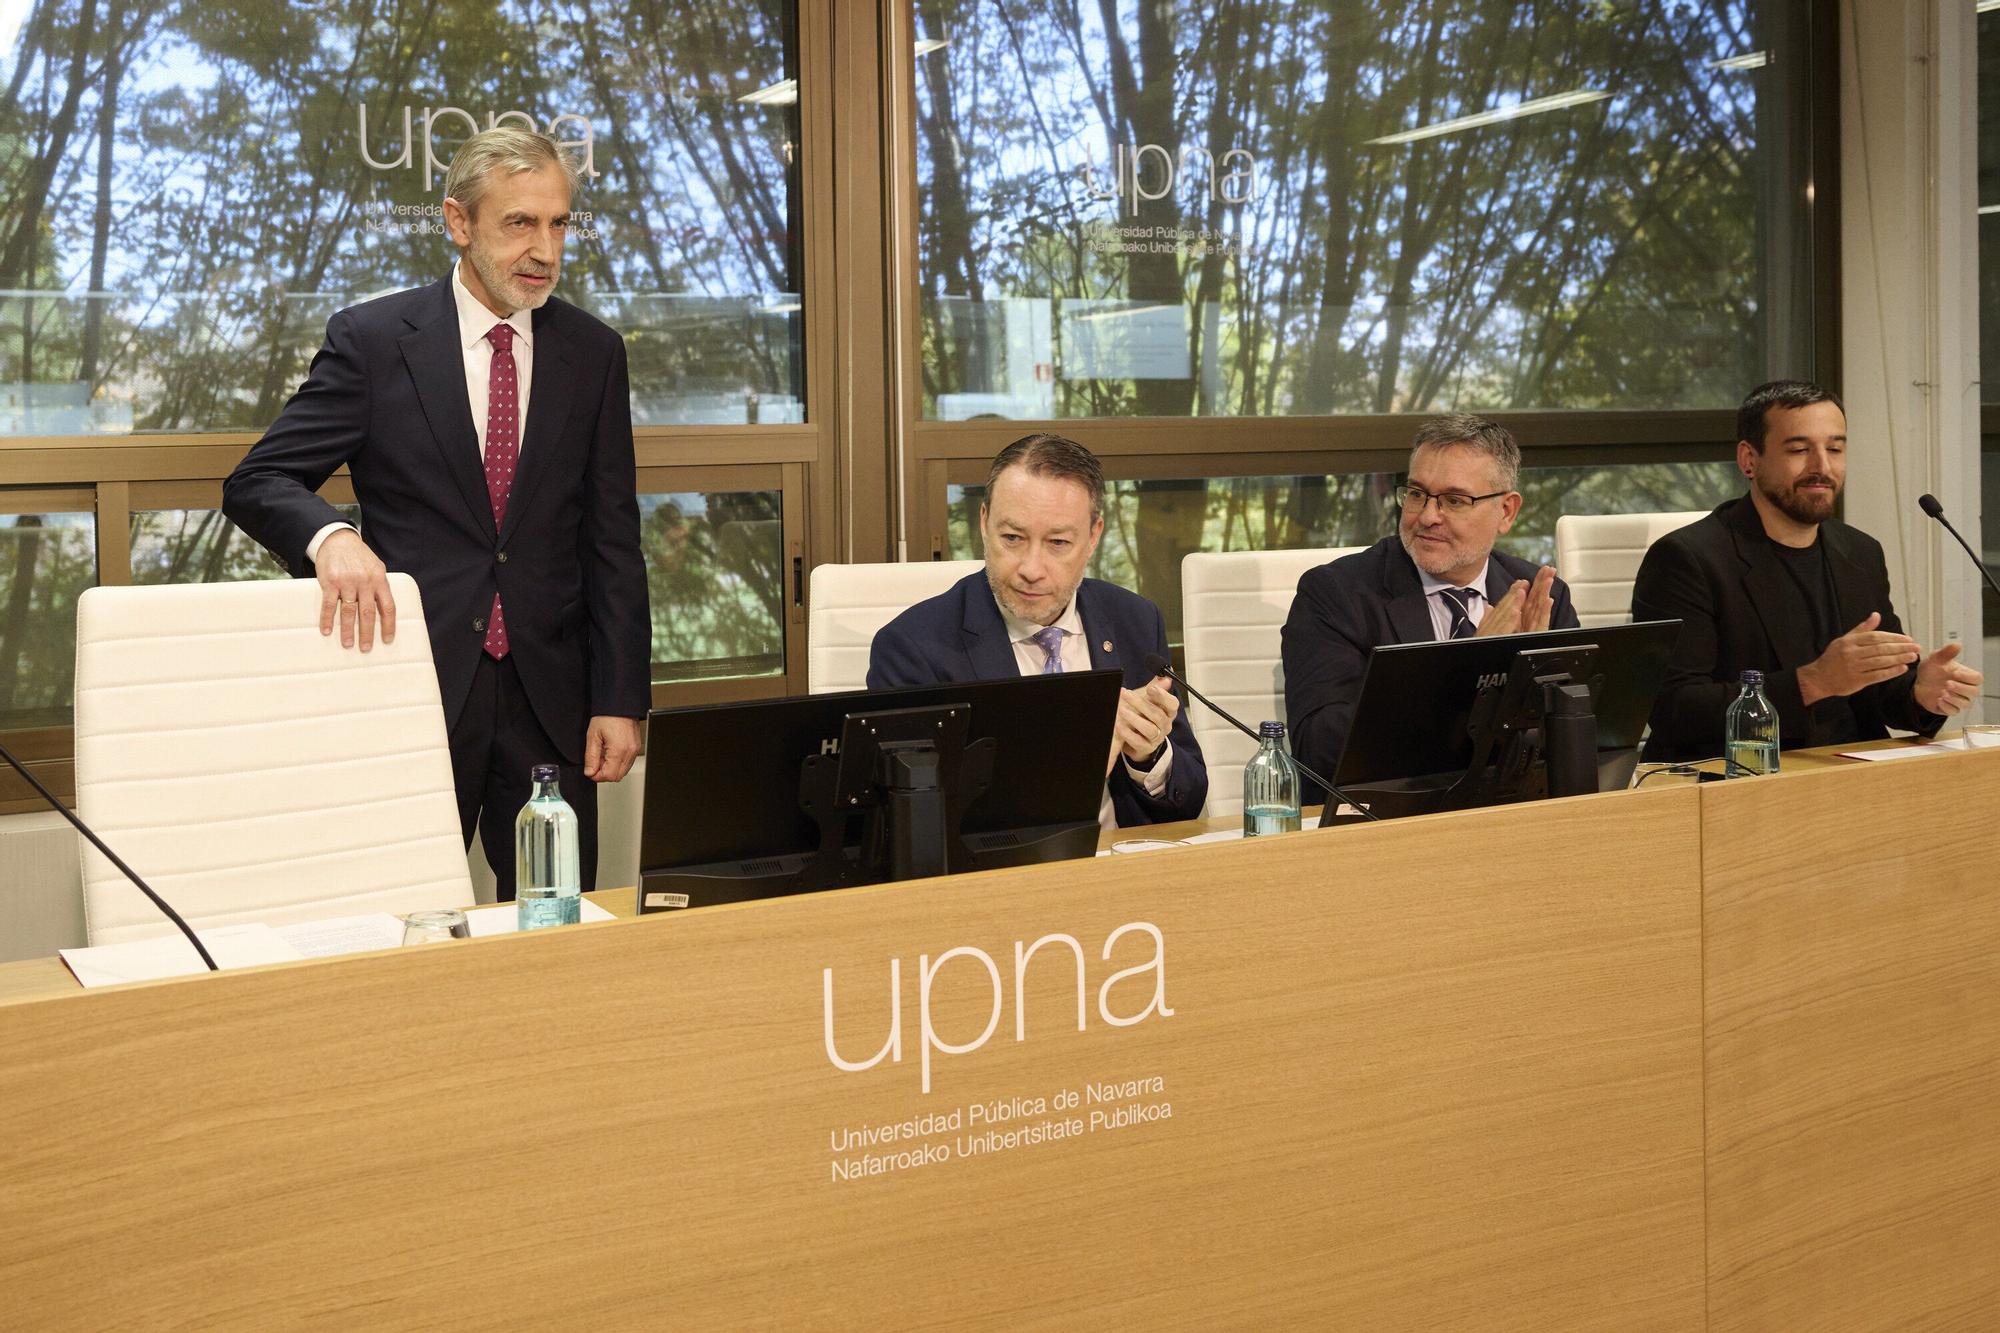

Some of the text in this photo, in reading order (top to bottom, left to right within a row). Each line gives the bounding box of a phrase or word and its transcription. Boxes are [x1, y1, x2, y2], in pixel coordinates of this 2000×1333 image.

[1086, 142, 1263, 216] upna
[365, 201, 443, 217] Universida
[1089, 225, 1153, 239] Unersidad
[1089, 239, 1148, 253] Nafoako
[821, 738, 841, 755] H
[823, 921, 1175, 1094] upna
[830, 1075, 1165, 1152] Universidad Pública de Navarra
[831, 1101, 1173, 1183] Nafarroako Unibertsitate Publikoa
